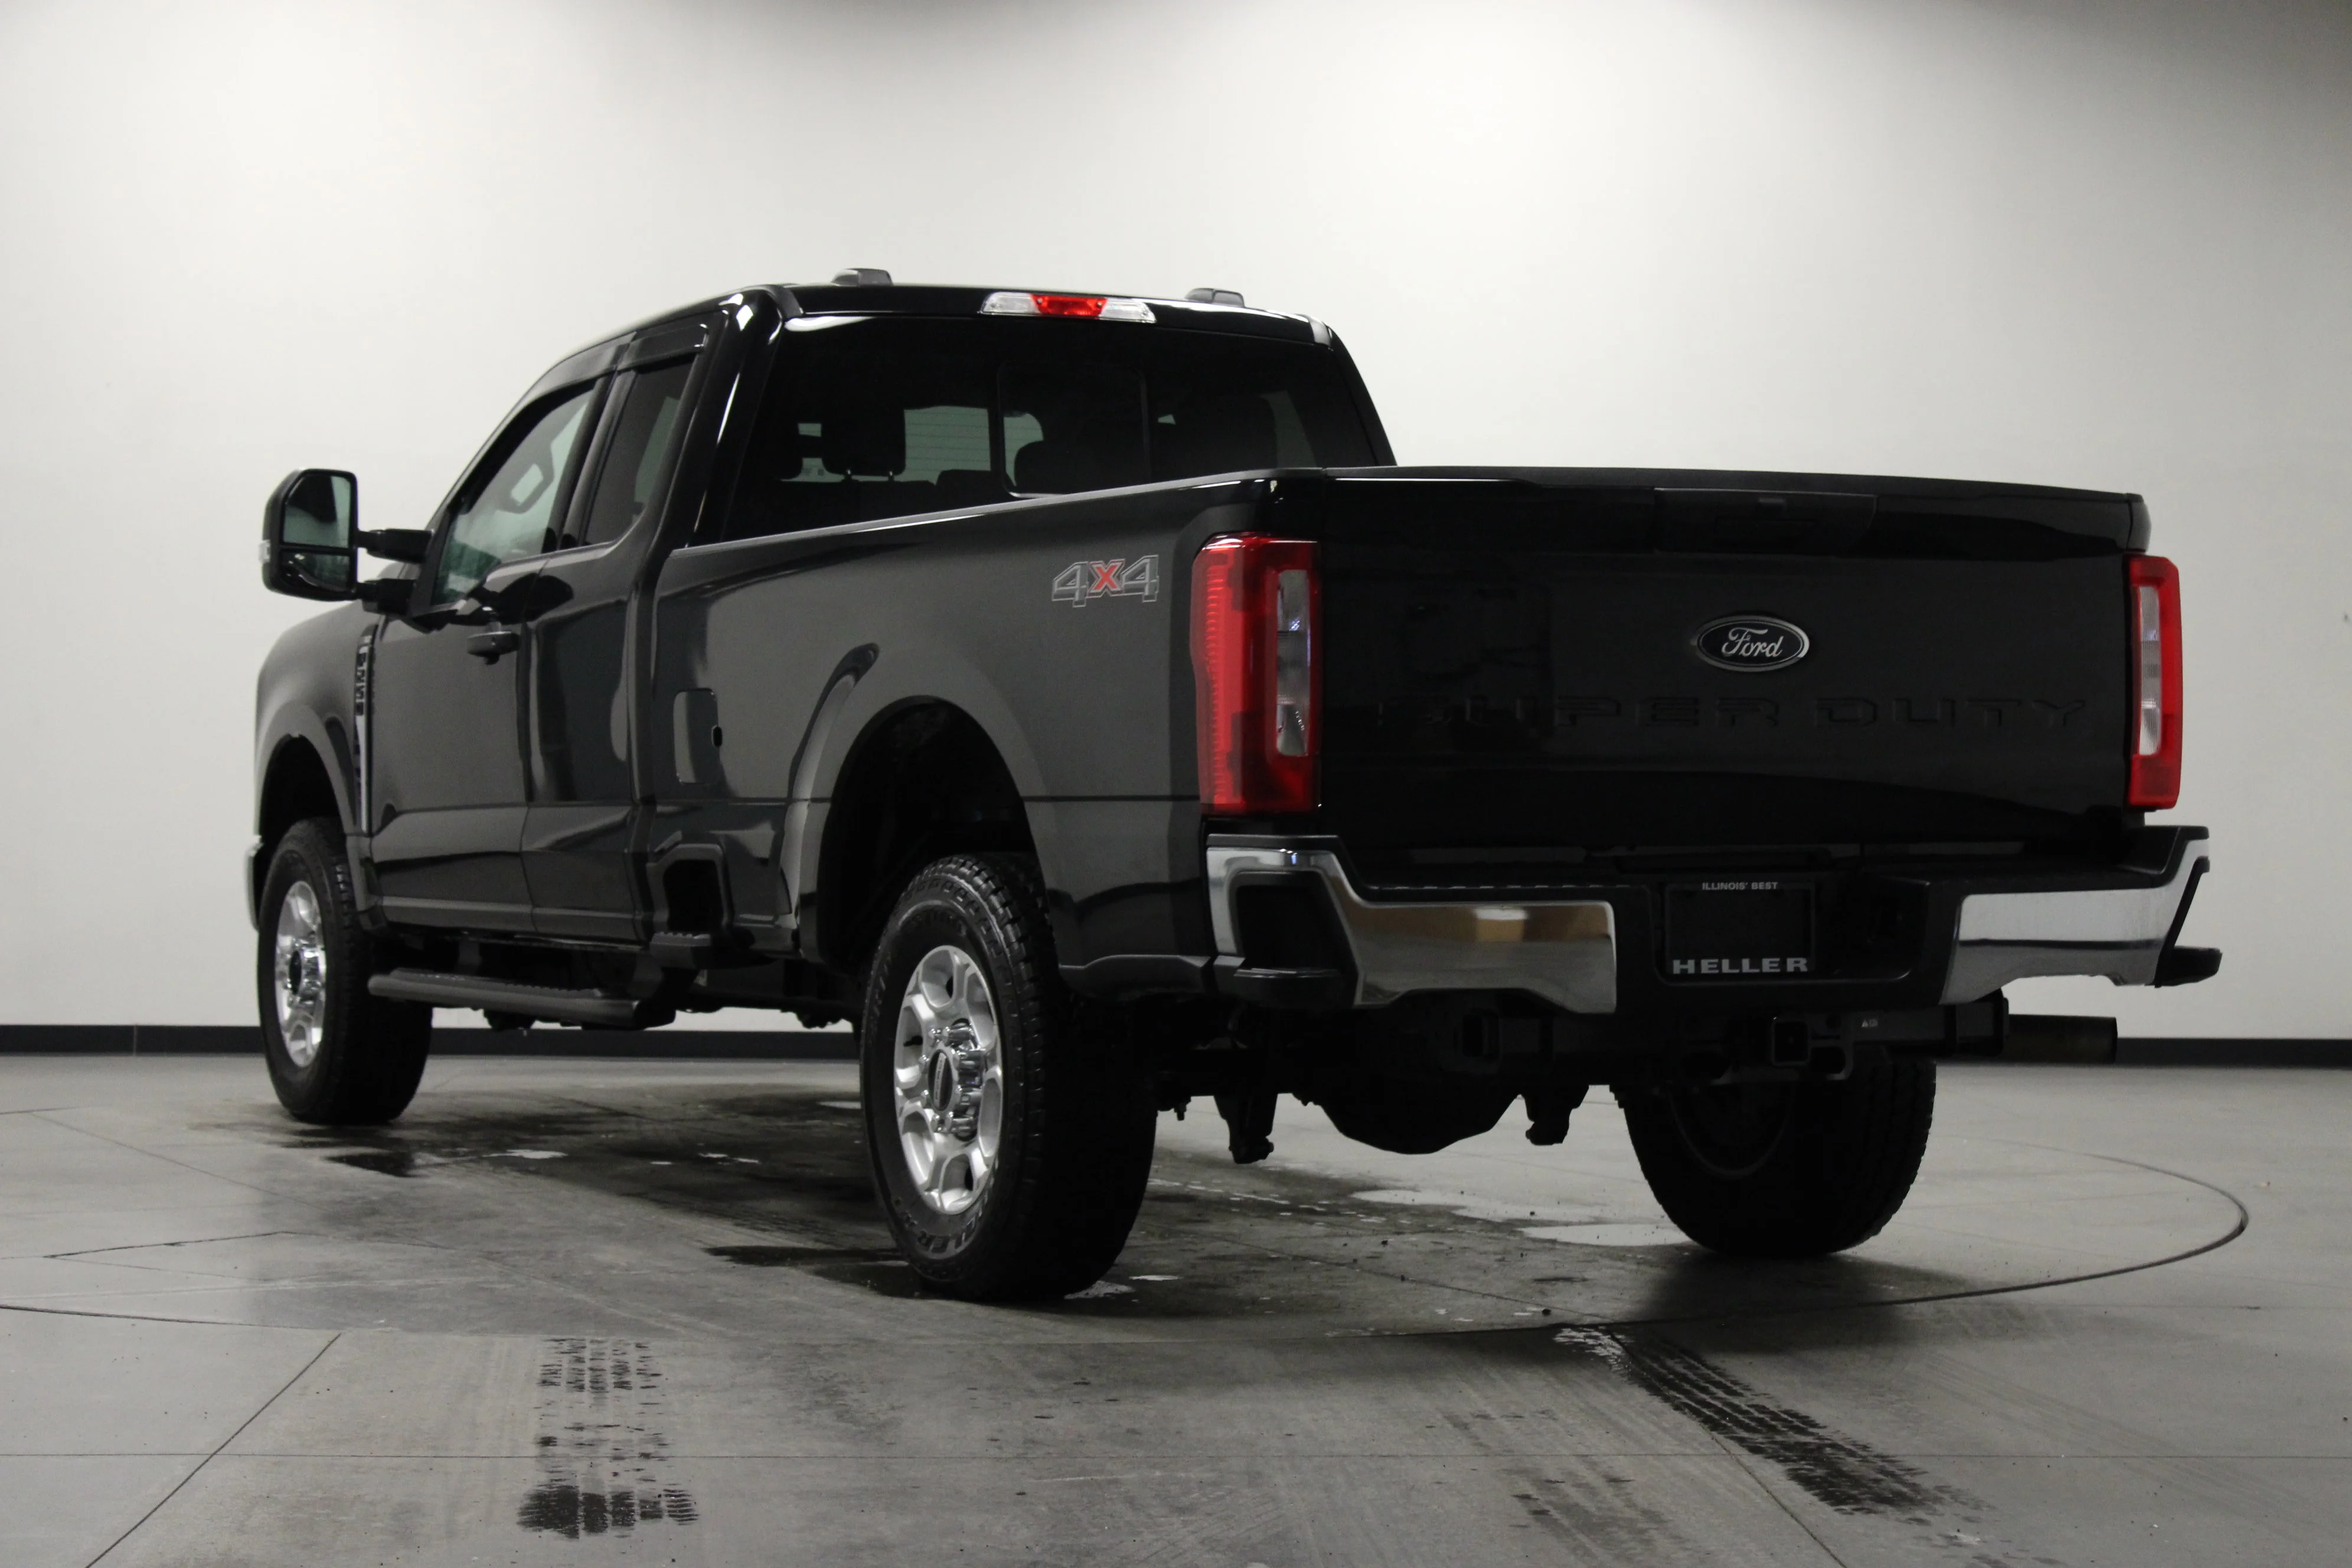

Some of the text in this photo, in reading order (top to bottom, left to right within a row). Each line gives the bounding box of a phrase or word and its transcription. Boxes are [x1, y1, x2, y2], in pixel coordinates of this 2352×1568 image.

[1721, 626, 1785, 658] Ford
[1814, 695, 2087, 728] DUTY
[1701, 881, 1779, 890] ILLINOIS' BEST
[1672, 958, 1808, 975] HELLER
